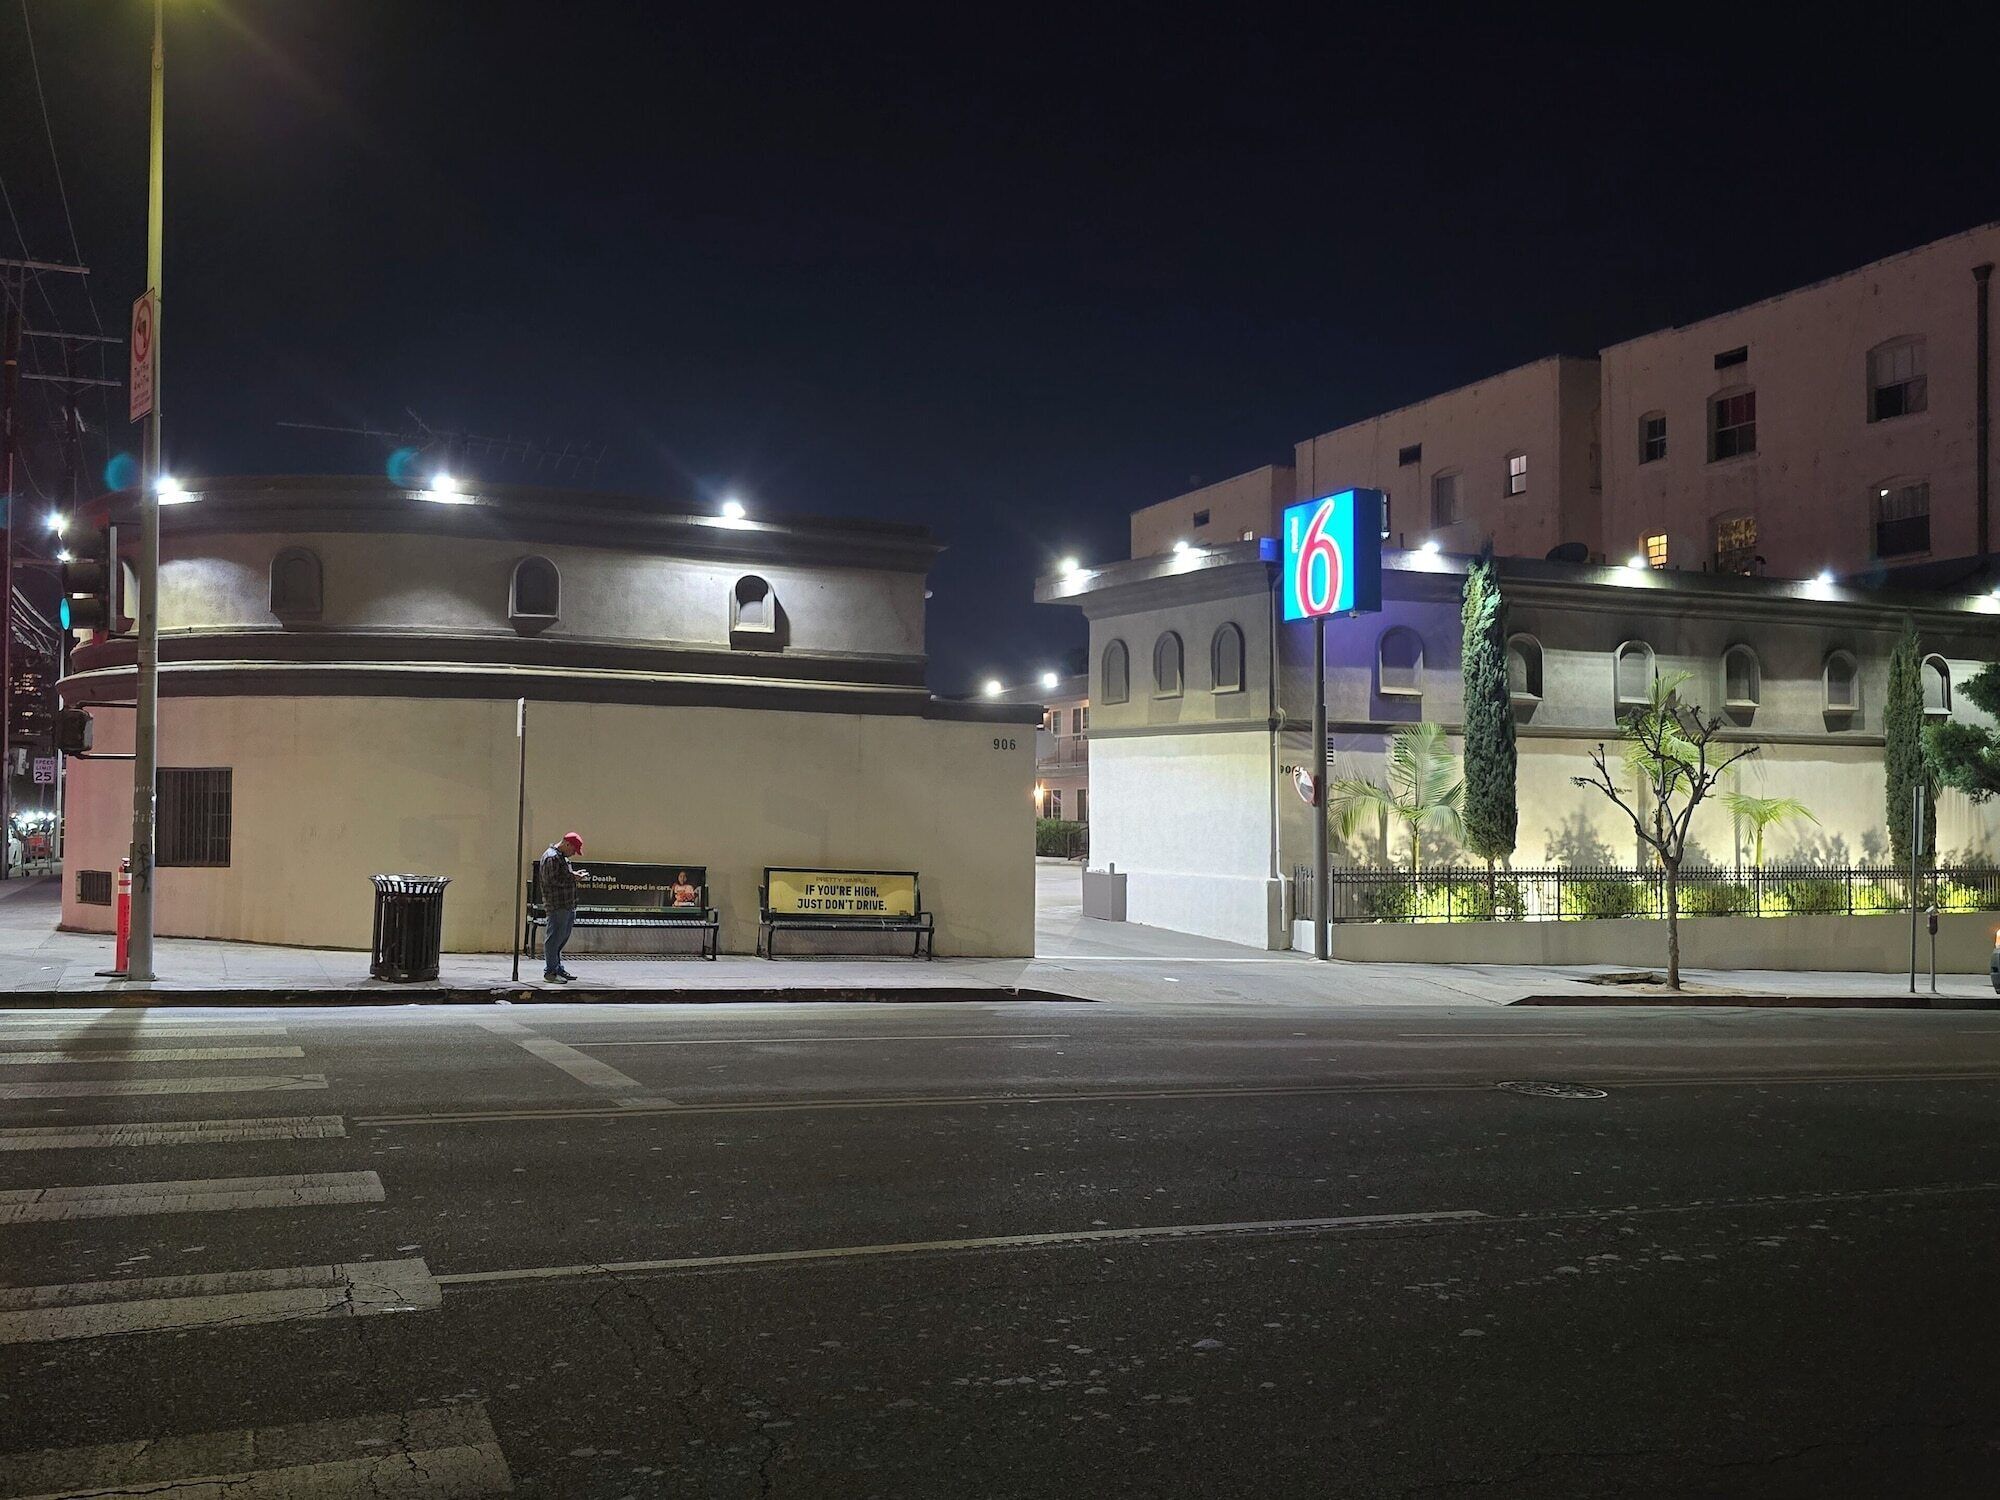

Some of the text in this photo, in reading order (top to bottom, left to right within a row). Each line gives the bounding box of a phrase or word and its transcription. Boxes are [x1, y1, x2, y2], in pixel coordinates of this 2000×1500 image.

[993, 738, 1016, 750] 906
[35, 771, 52, 781] 25
[621, 883, 648, 891] trapped
[805, 885, 879, 898] IF YOU'RE HIGH,
[797, 899, 887, 911] JUST DON'T DRIVE.
